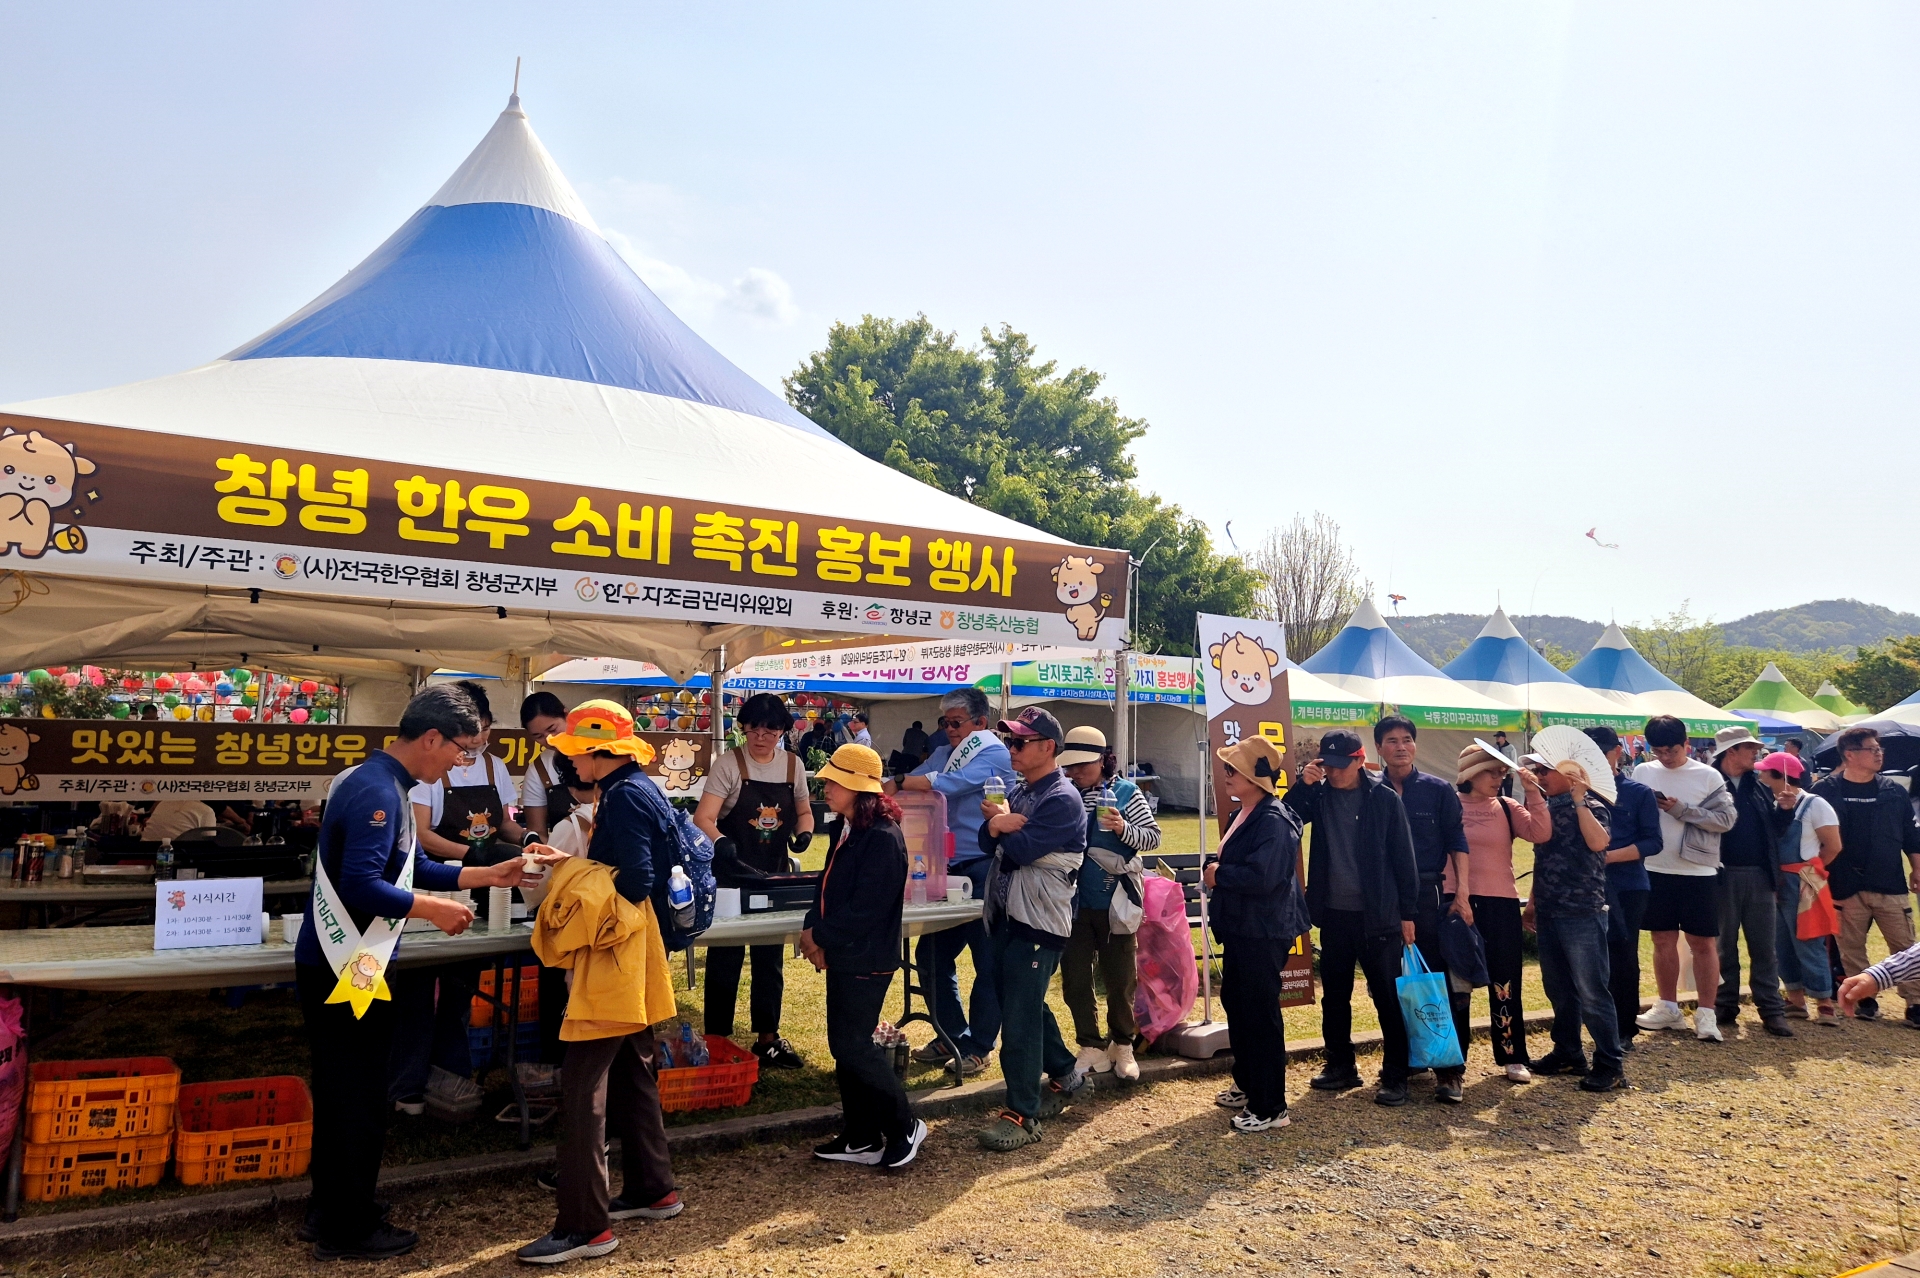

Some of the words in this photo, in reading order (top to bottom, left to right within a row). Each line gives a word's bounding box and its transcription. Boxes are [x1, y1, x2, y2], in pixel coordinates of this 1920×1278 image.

[213, 452, 370, 535] 창녕
[394, 474, 531, 549] 한우
[551, 496, 673, 565] 소비
[691, 510, 799, 576] 촉진
[816, 525, 912, 586] 홍보
[927, 537, 1018, 597] 행사
[303, 556, 460, 589] (사)전국한우협회
[465, 571, 558, 597] 창녕군지부
[890, 607, 933, 626] 창녕군
[957, 611, 1039, 635] 창녕축산농협
[1038, 663, 1094, 684] 남지풋고추
[1424, 711, 1499, 726] 낙동강미꾸라지체험
[71, 729, 197, 765] 맛있는
[215, 732, 367, 766] 창녕한우
[156, 779, 250, 794] (사)전국한우협회
[253, 780, 312, 793] 창녕군지부
[192, 891, 237, 904] 시식시간
